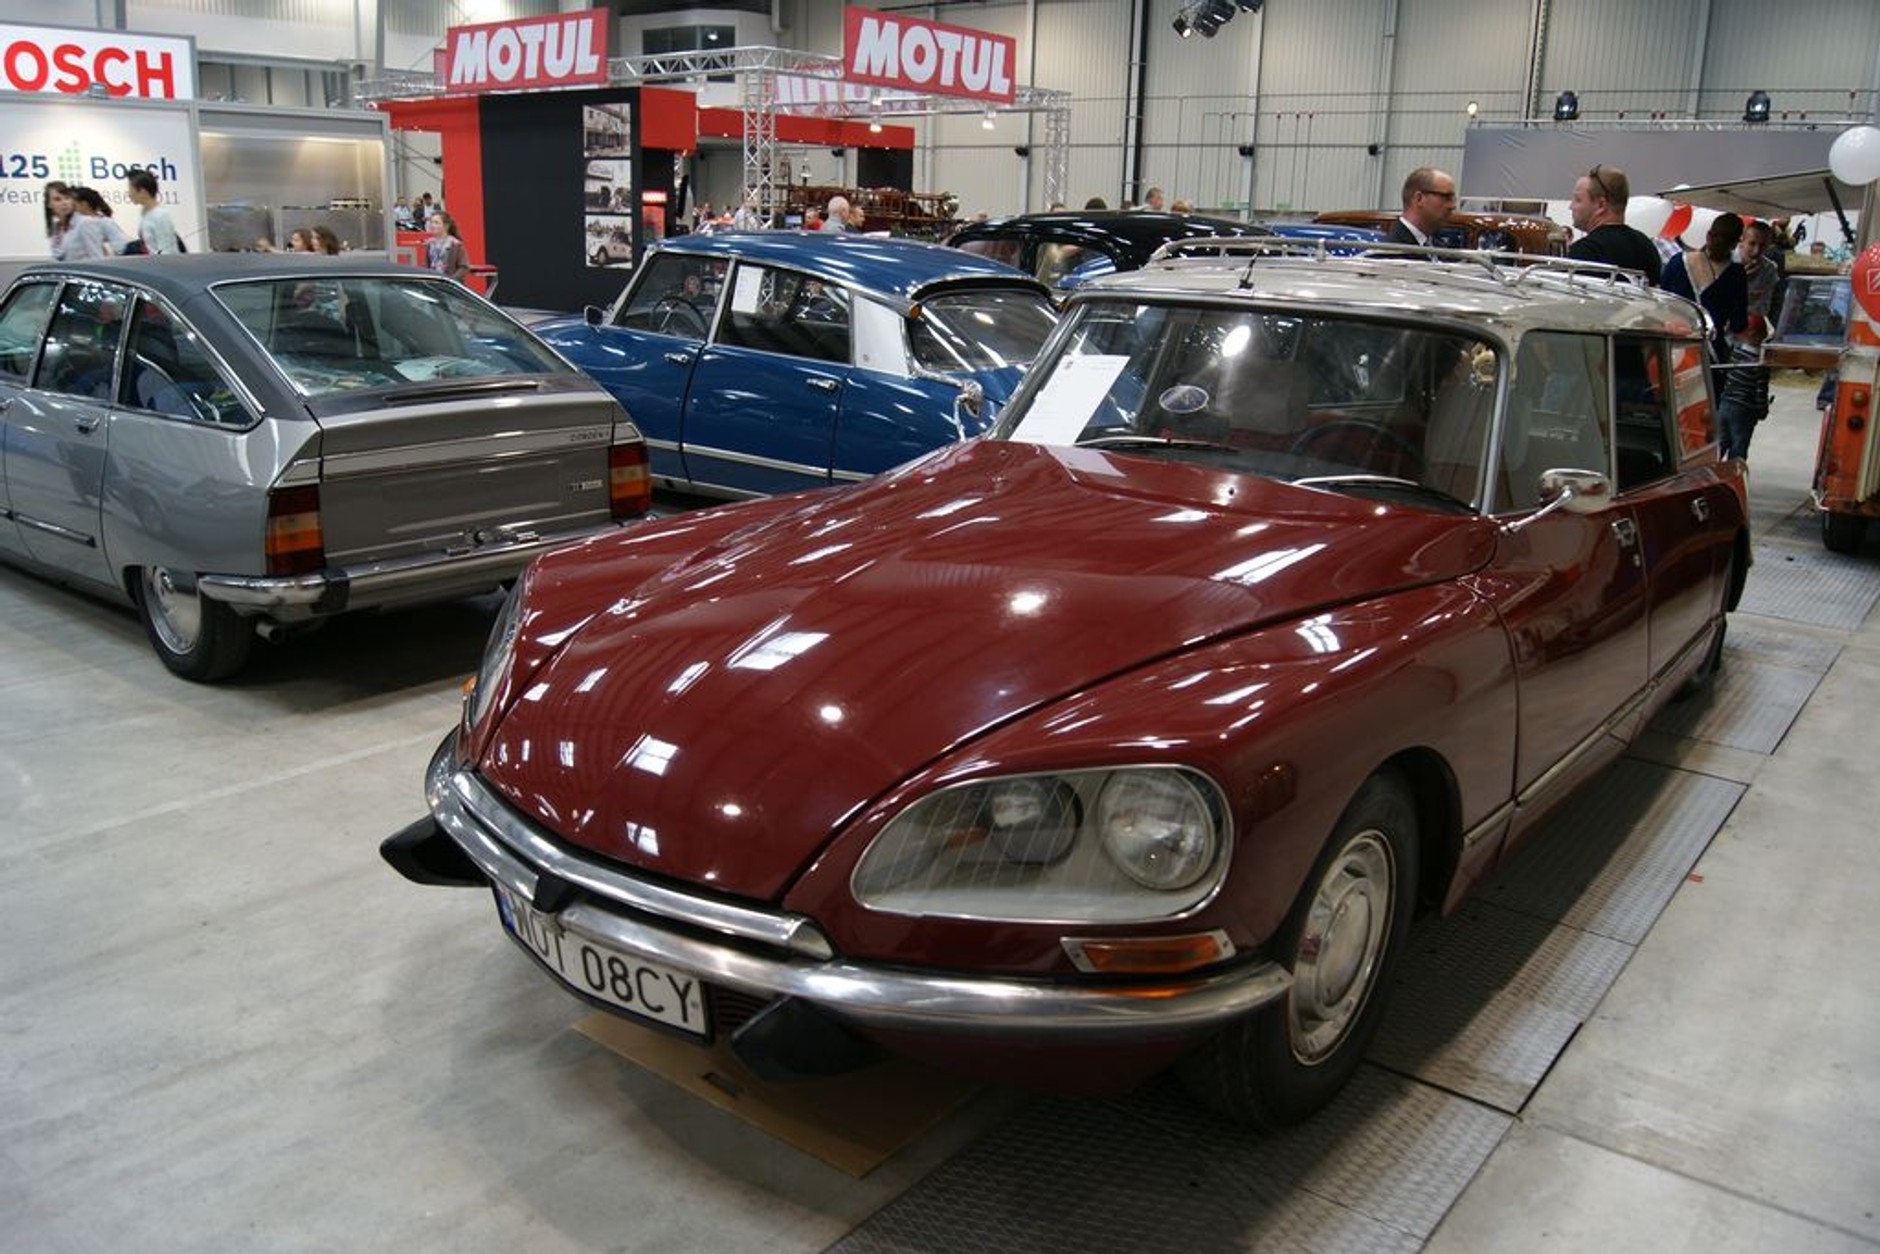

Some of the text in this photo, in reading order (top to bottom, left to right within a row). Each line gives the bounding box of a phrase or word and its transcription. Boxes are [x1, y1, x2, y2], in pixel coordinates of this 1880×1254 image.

[450, 19, 600, 84] MOTUL
[852, 17, 1011, 95] MOTUL
[0, 154, 49, 178] 125
[582, 945, 692, 1023] 08CY
